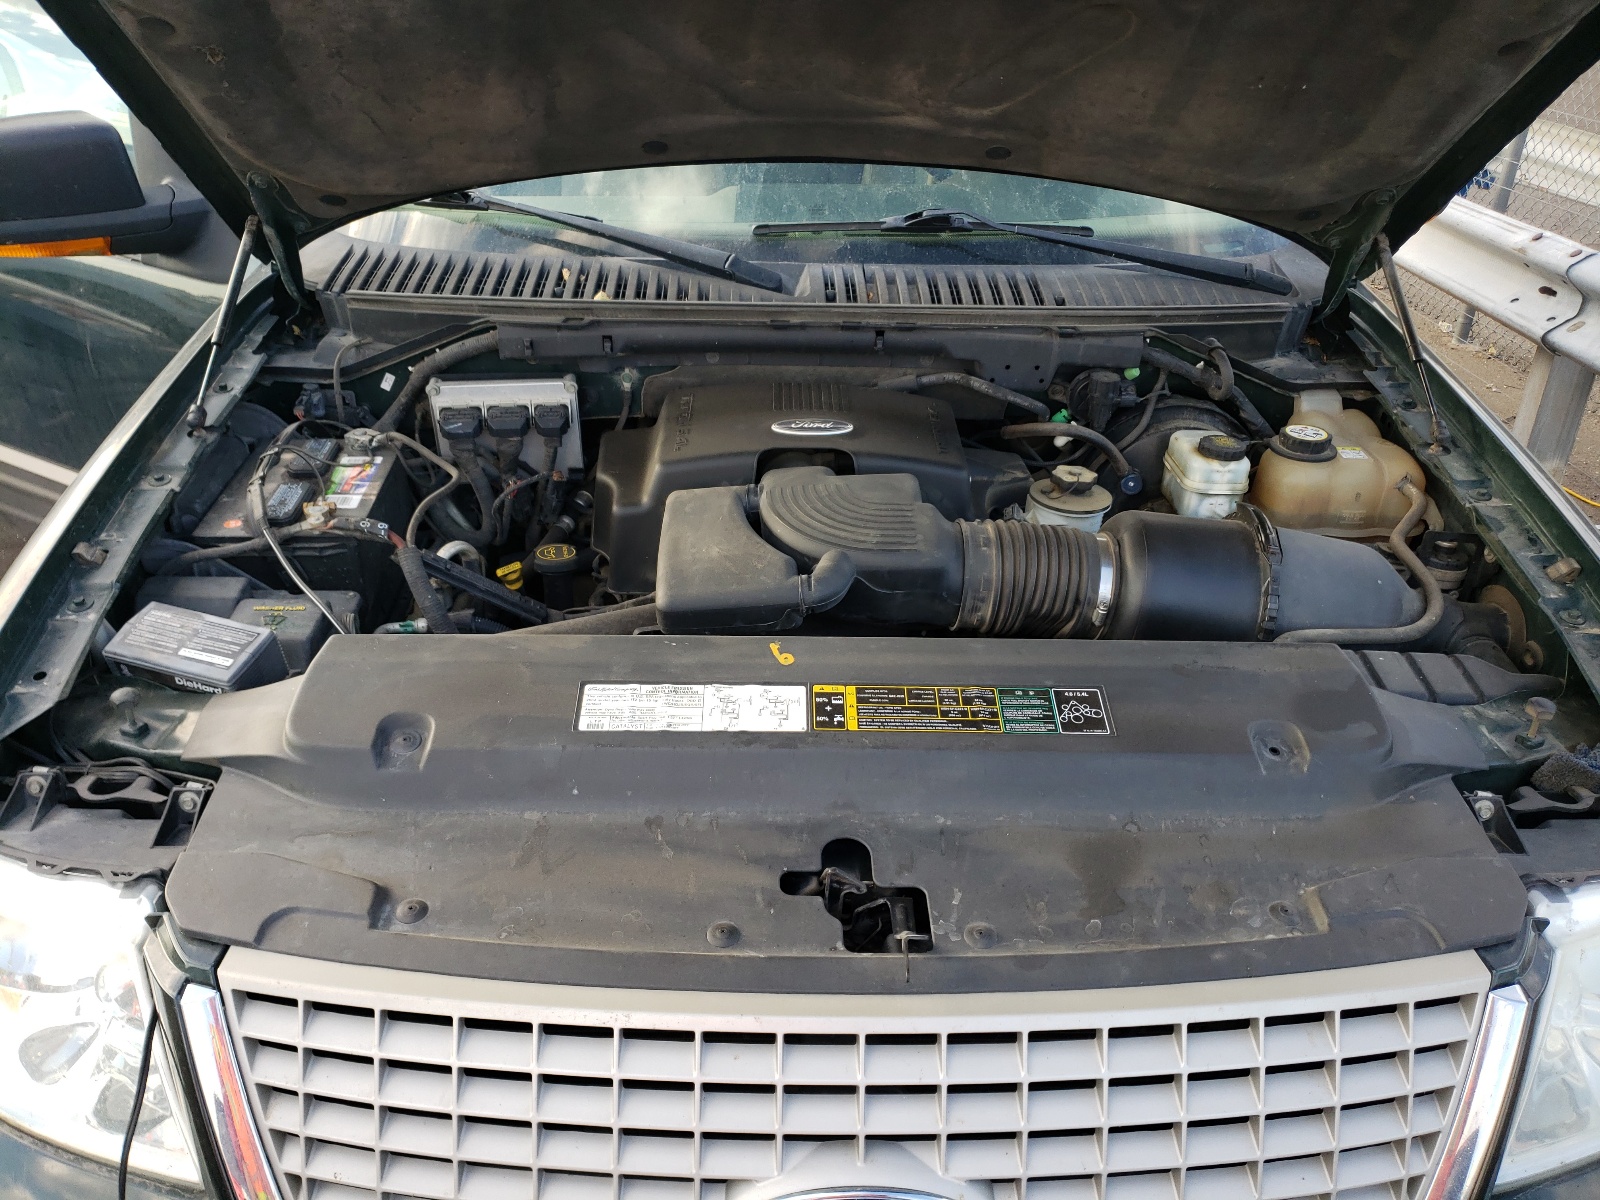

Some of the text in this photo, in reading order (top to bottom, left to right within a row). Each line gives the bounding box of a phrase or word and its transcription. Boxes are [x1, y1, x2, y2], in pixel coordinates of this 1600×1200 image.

[791, 420, 834, 429] Ford
[769, 641, 795, 666] 6
[174, 676, 223, 694] DieHard
